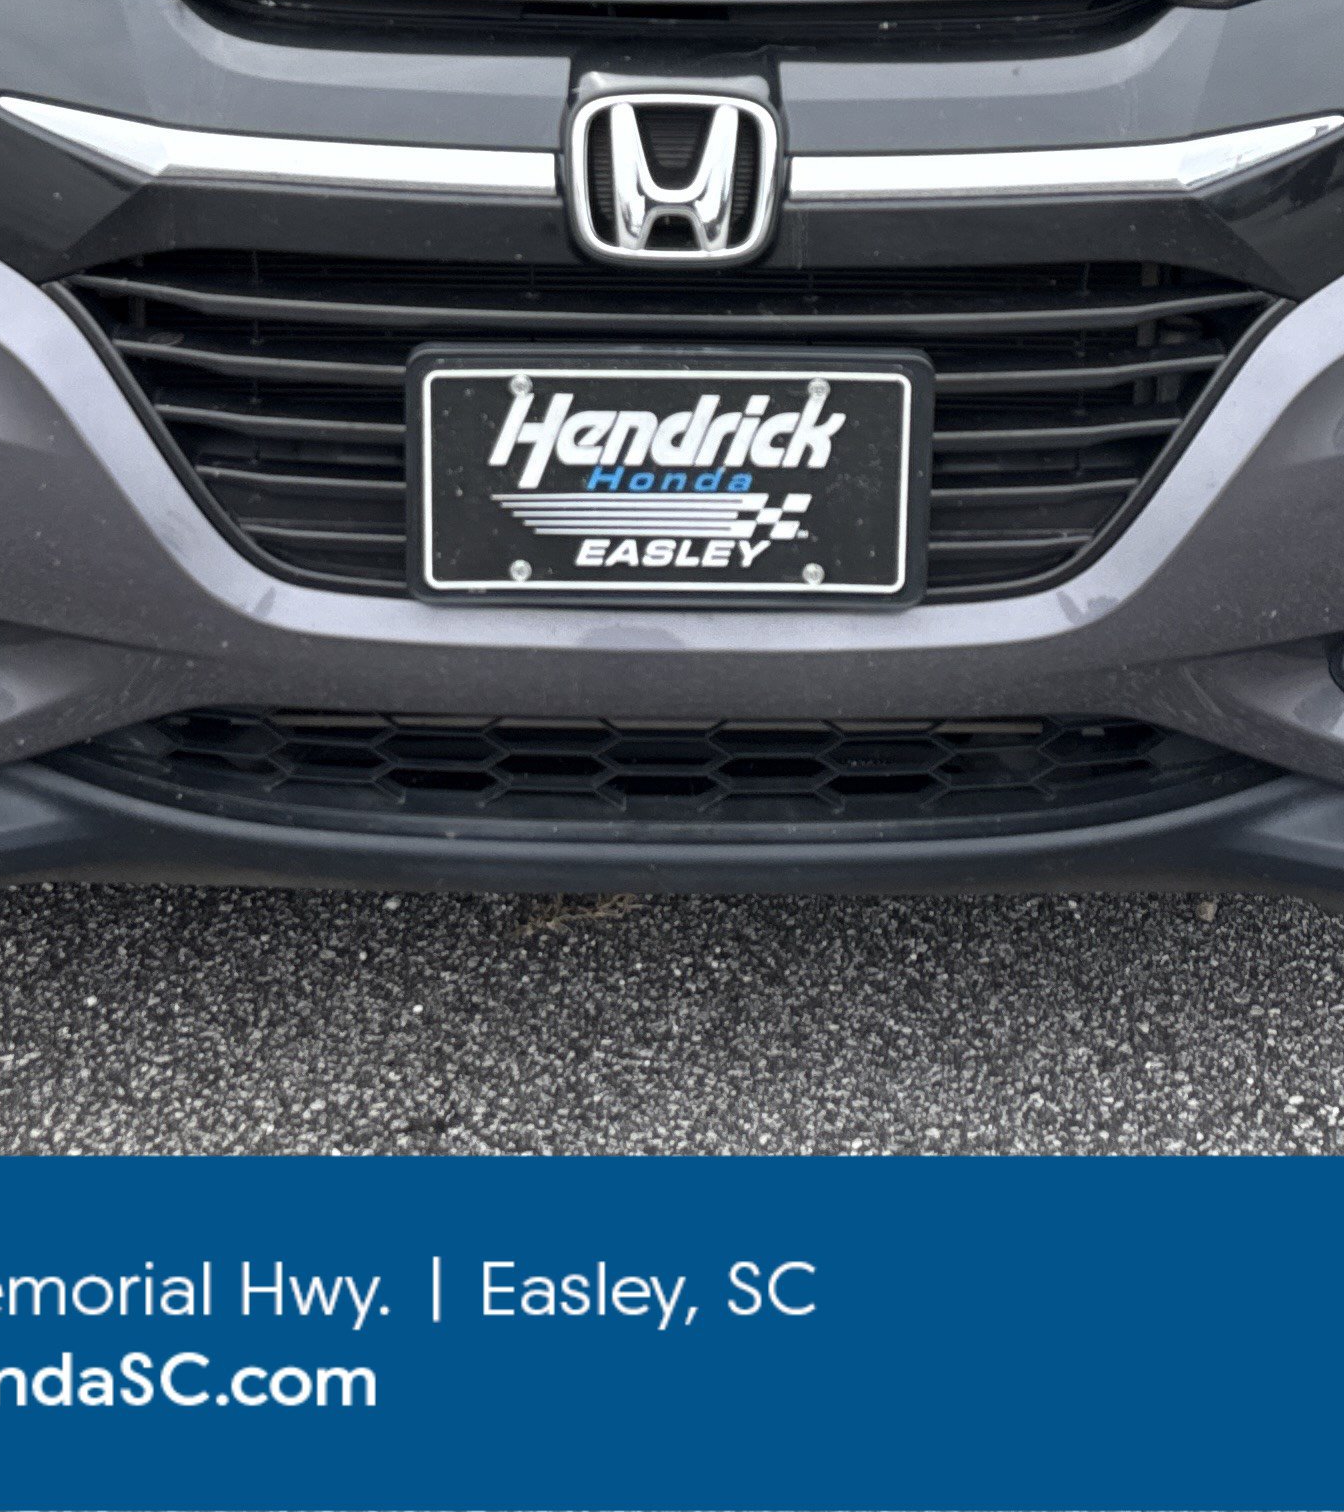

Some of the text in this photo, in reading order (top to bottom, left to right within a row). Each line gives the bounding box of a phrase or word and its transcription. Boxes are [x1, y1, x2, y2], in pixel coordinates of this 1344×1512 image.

[488, 392, 846, 489] Hendrick
[587, 466, 754, 492] Honda
[575, 539, 772, 568] EASLEY
